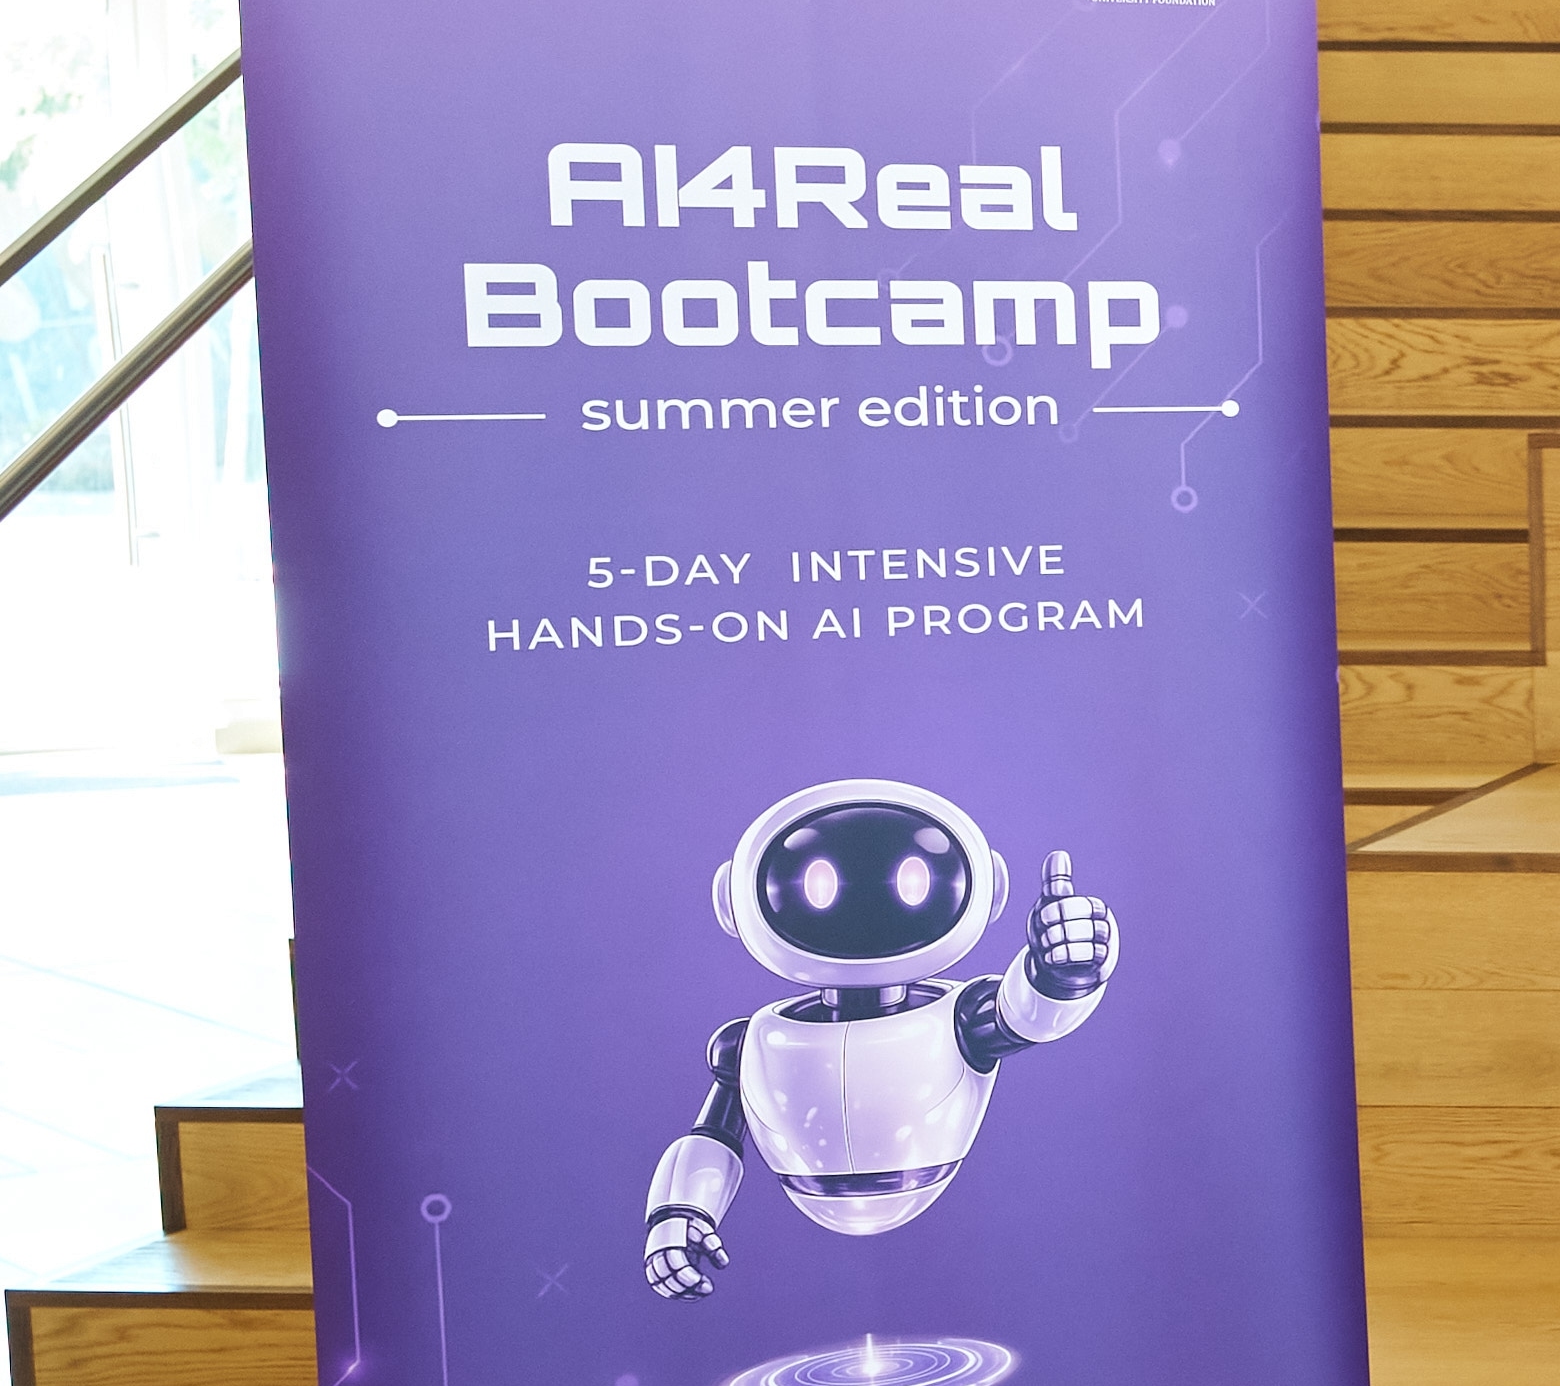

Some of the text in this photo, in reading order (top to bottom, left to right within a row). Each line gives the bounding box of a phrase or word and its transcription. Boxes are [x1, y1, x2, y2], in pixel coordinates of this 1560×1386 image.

[547, 141, 1078, 231] AI4Real
[462, 261, 1161, 368] Bootcamp
[580, 385, 1060, 433] summer edition
[586, 544, 1064, 590] 5-DAY INTENSIVE
[486, 597, 1146, 651] HANDS-ON AI PROGRAM
